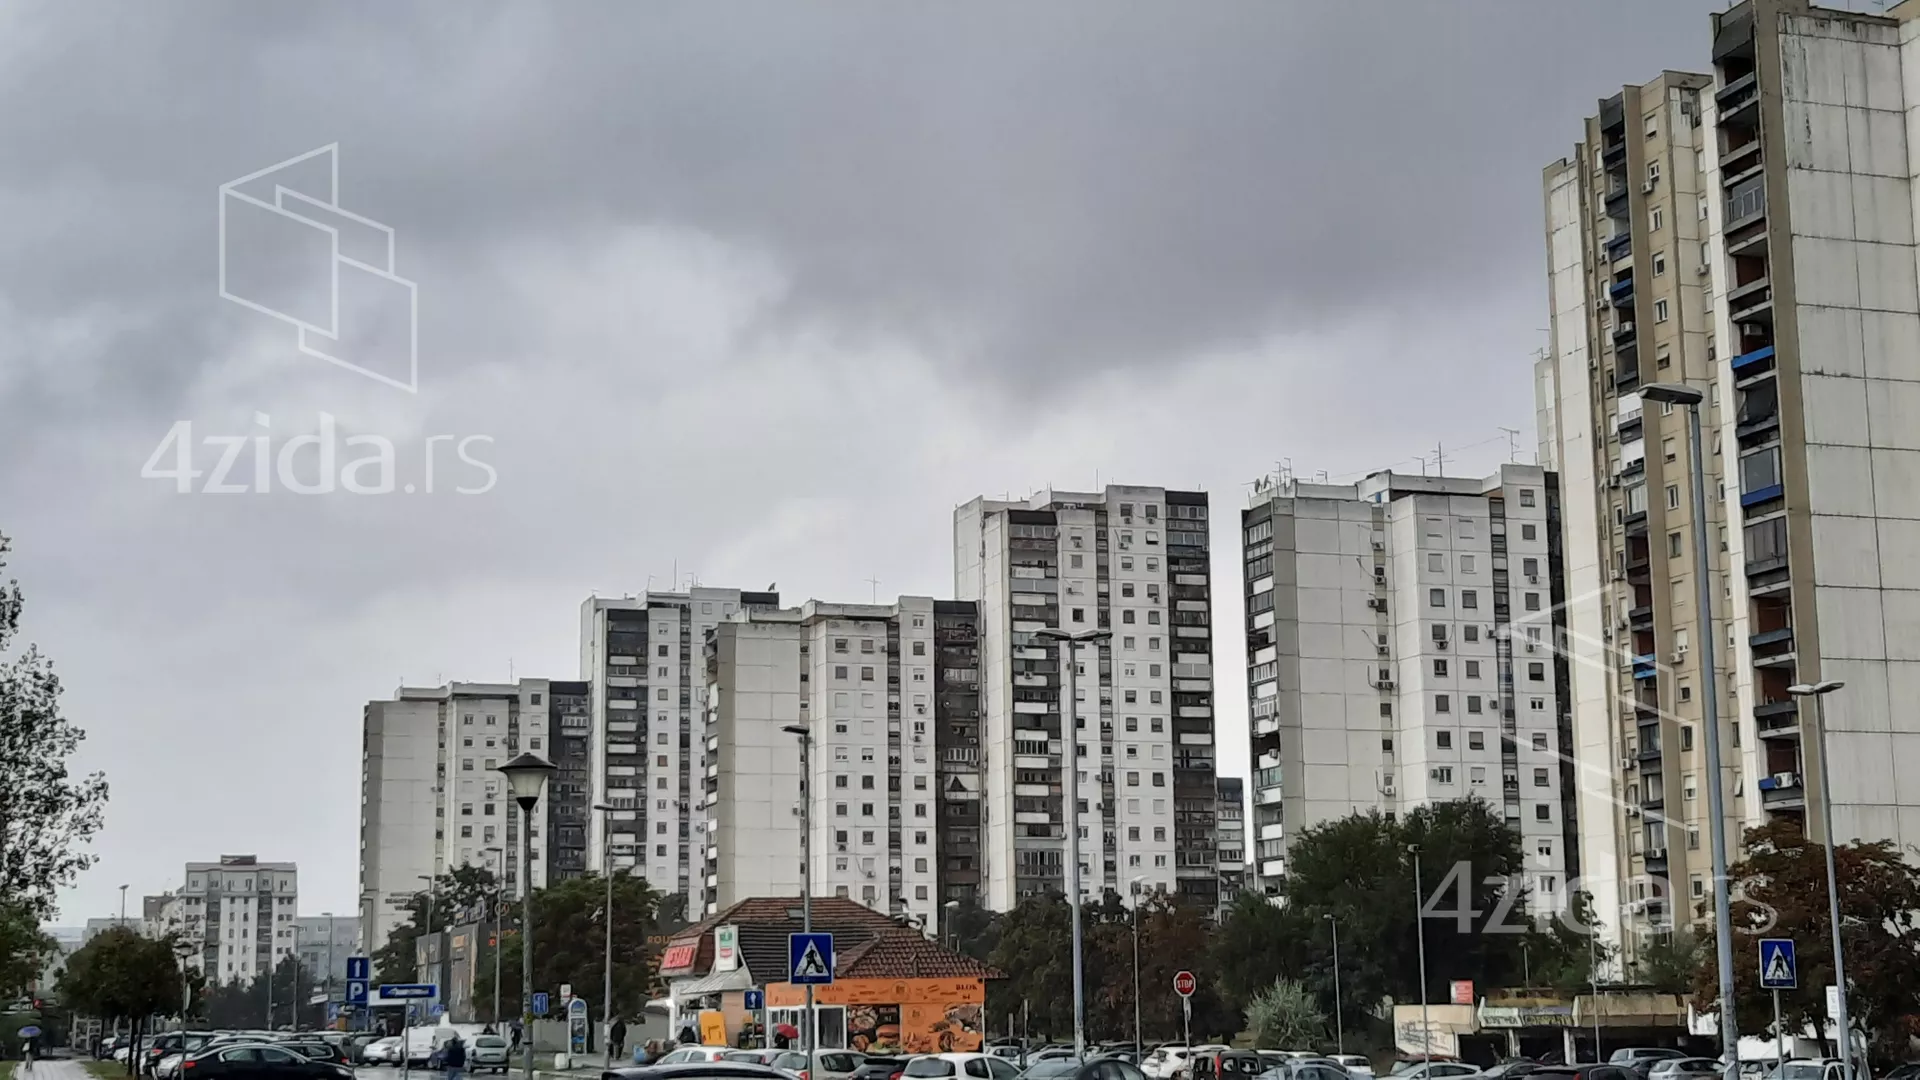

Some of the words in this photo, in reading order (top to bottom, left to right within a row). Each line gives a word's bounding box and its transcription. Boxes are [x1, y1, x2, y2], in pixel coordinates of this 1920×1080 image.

[955, 983, 978, 991] BLOK
[1177, 979, 1193, 989] STOP
[350, 982, 363, 1001] P
